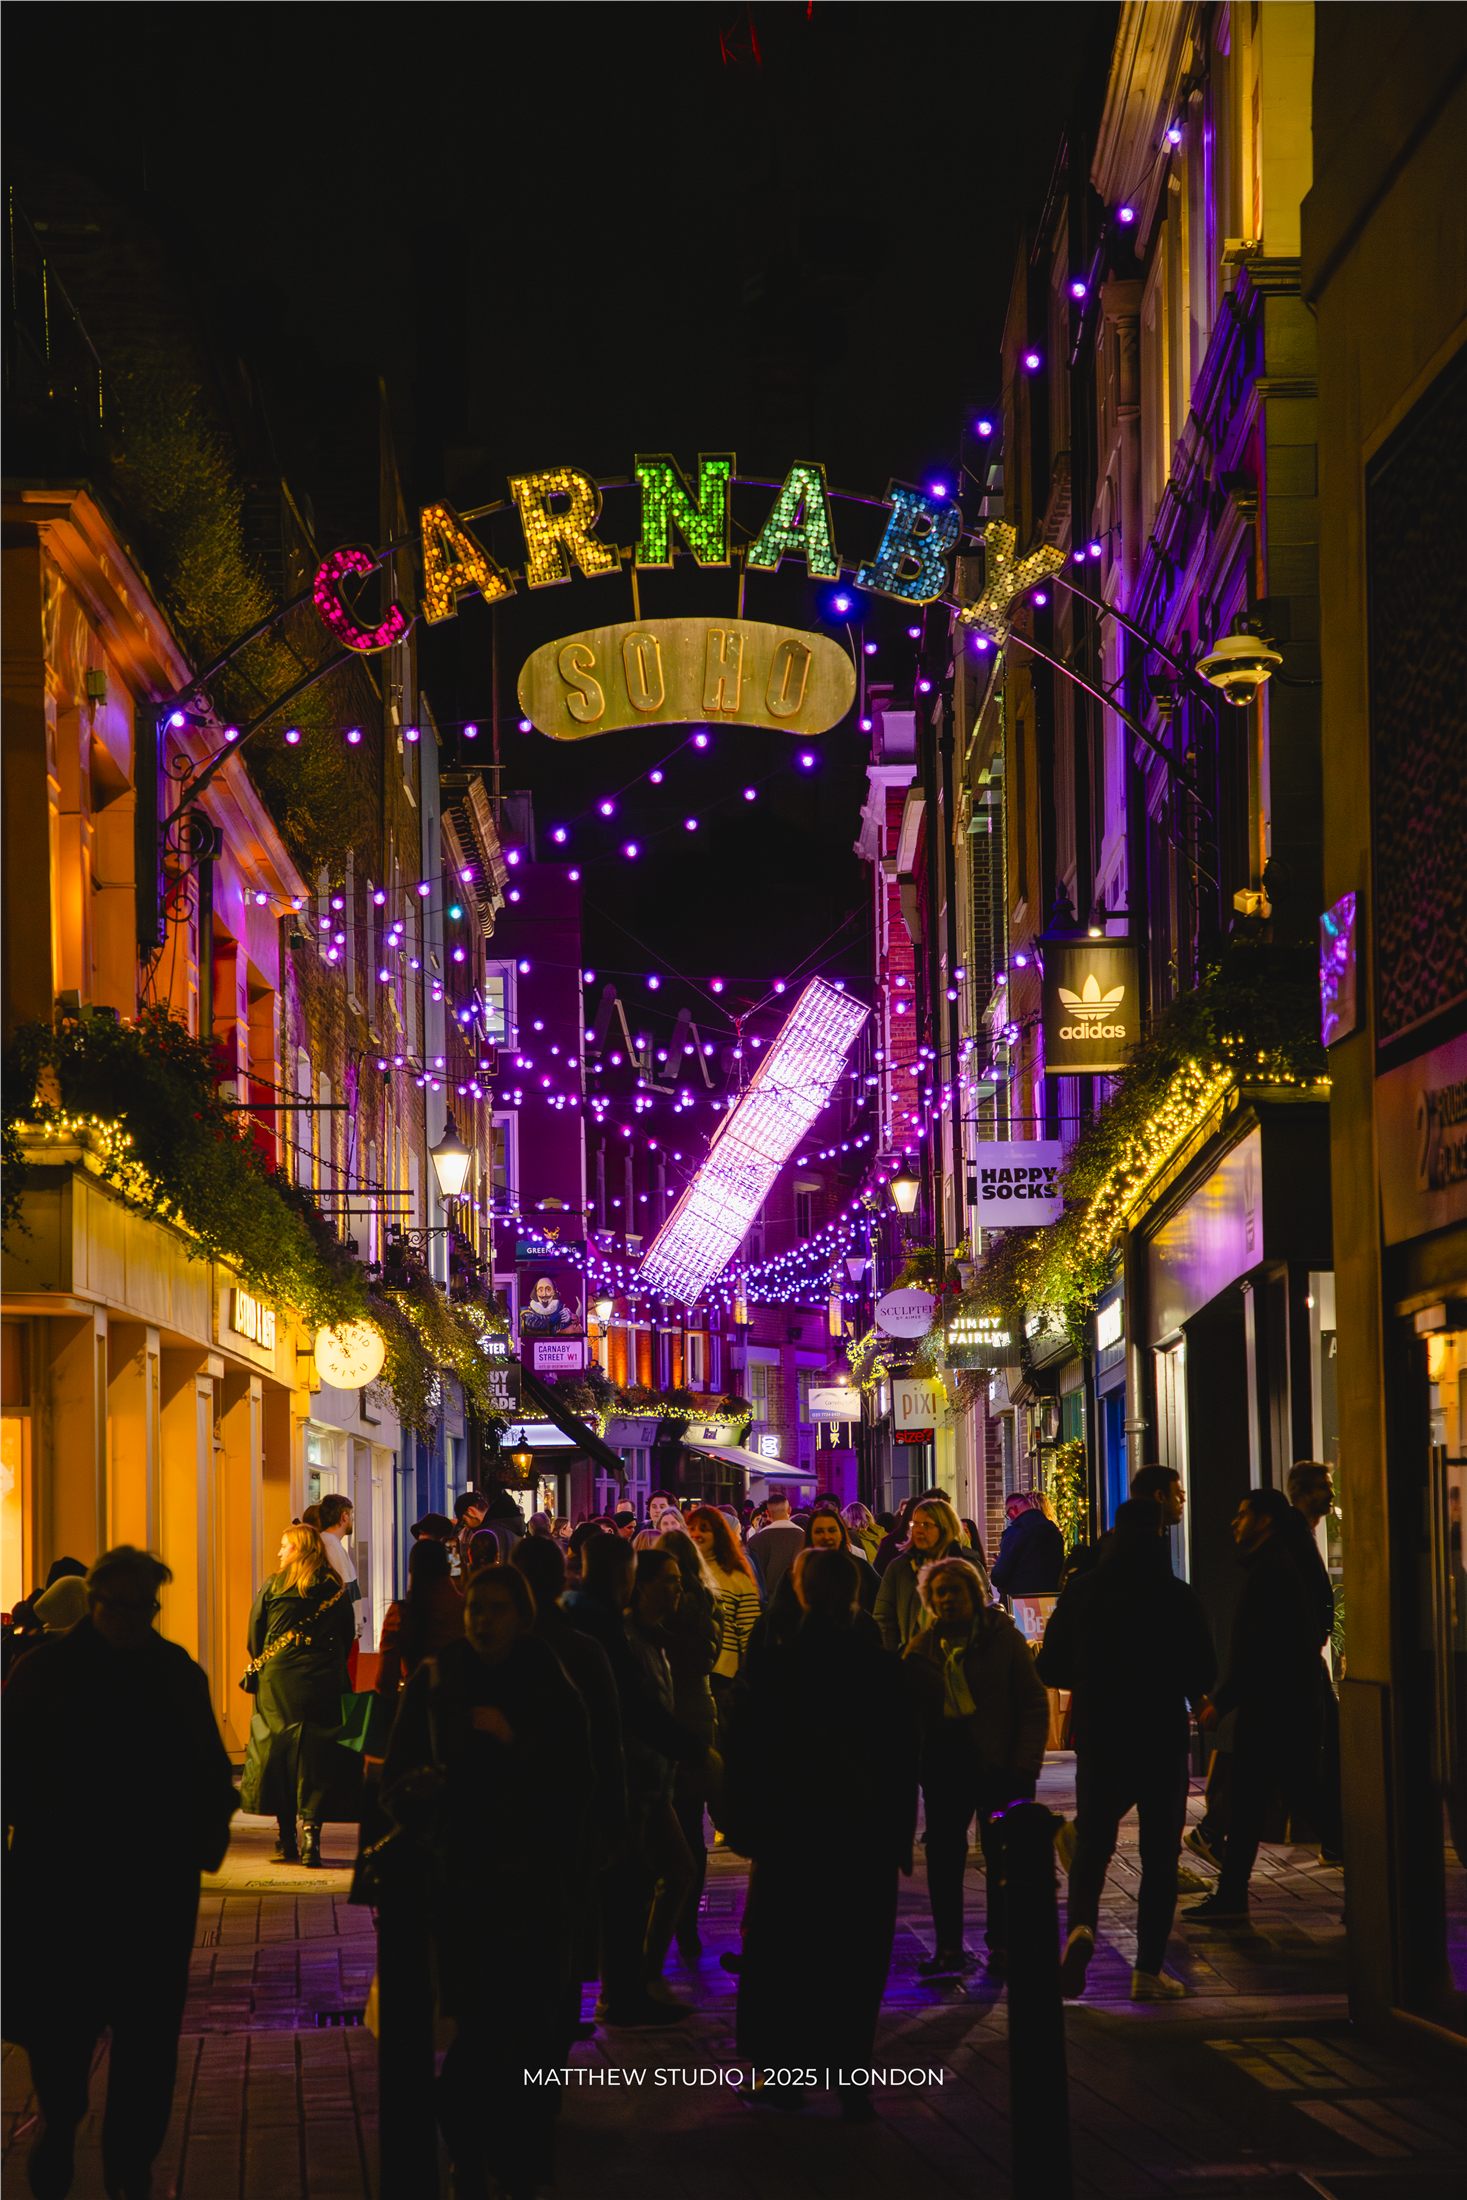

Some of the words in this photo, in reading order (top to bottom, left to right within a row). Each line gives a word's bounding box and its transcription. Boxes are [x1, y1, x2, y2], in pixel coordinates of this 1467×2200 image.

[312, 452, 1068, 654] CARNABY
[558, 628, 812, 723] SOHO
[1059, 1022, 1126, 1039] adidas
[981, 1167, 1057, 1184] HAPPY
[982, 1184, 1057, 1200] SOCKS
[949, 1319, 1000, 1329] JIMMY
[538, 1345, 570, 1353] CARNABY
[538, 1353, 564, 1361] STREET
[328, 1363, 368, 1377] MIYU
[488, 1371, 509, 1383] UY
[895, 1428, 935, 1443] size?
